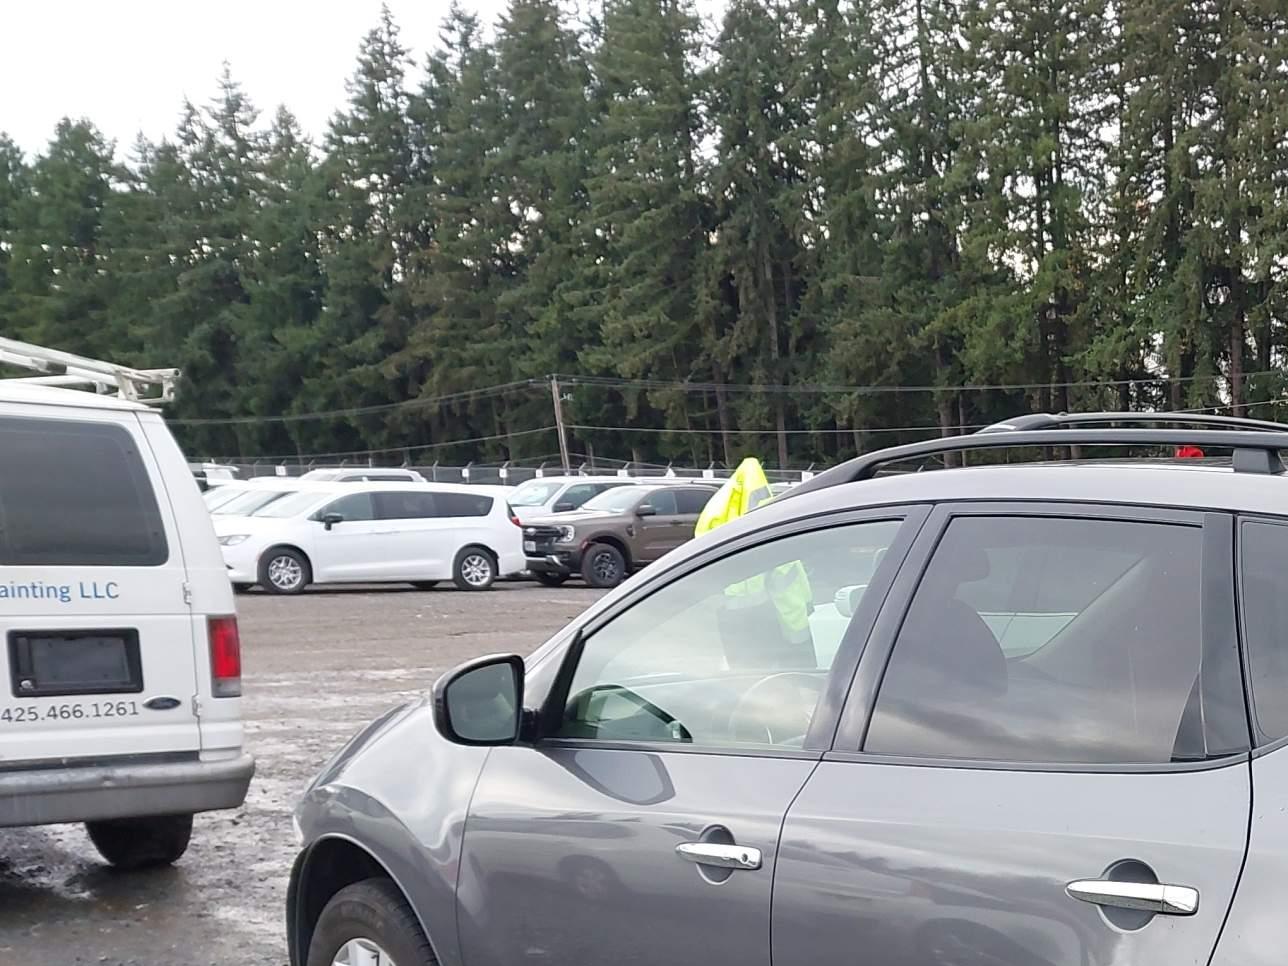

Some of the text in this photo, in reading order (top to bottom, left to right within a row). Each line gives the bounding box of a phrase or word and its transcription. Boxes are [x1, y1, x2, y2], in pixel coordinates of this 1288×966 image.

[0, 580, 119, 602] ainting LLC
[1, 701, 139, 722] 425.466.1261
